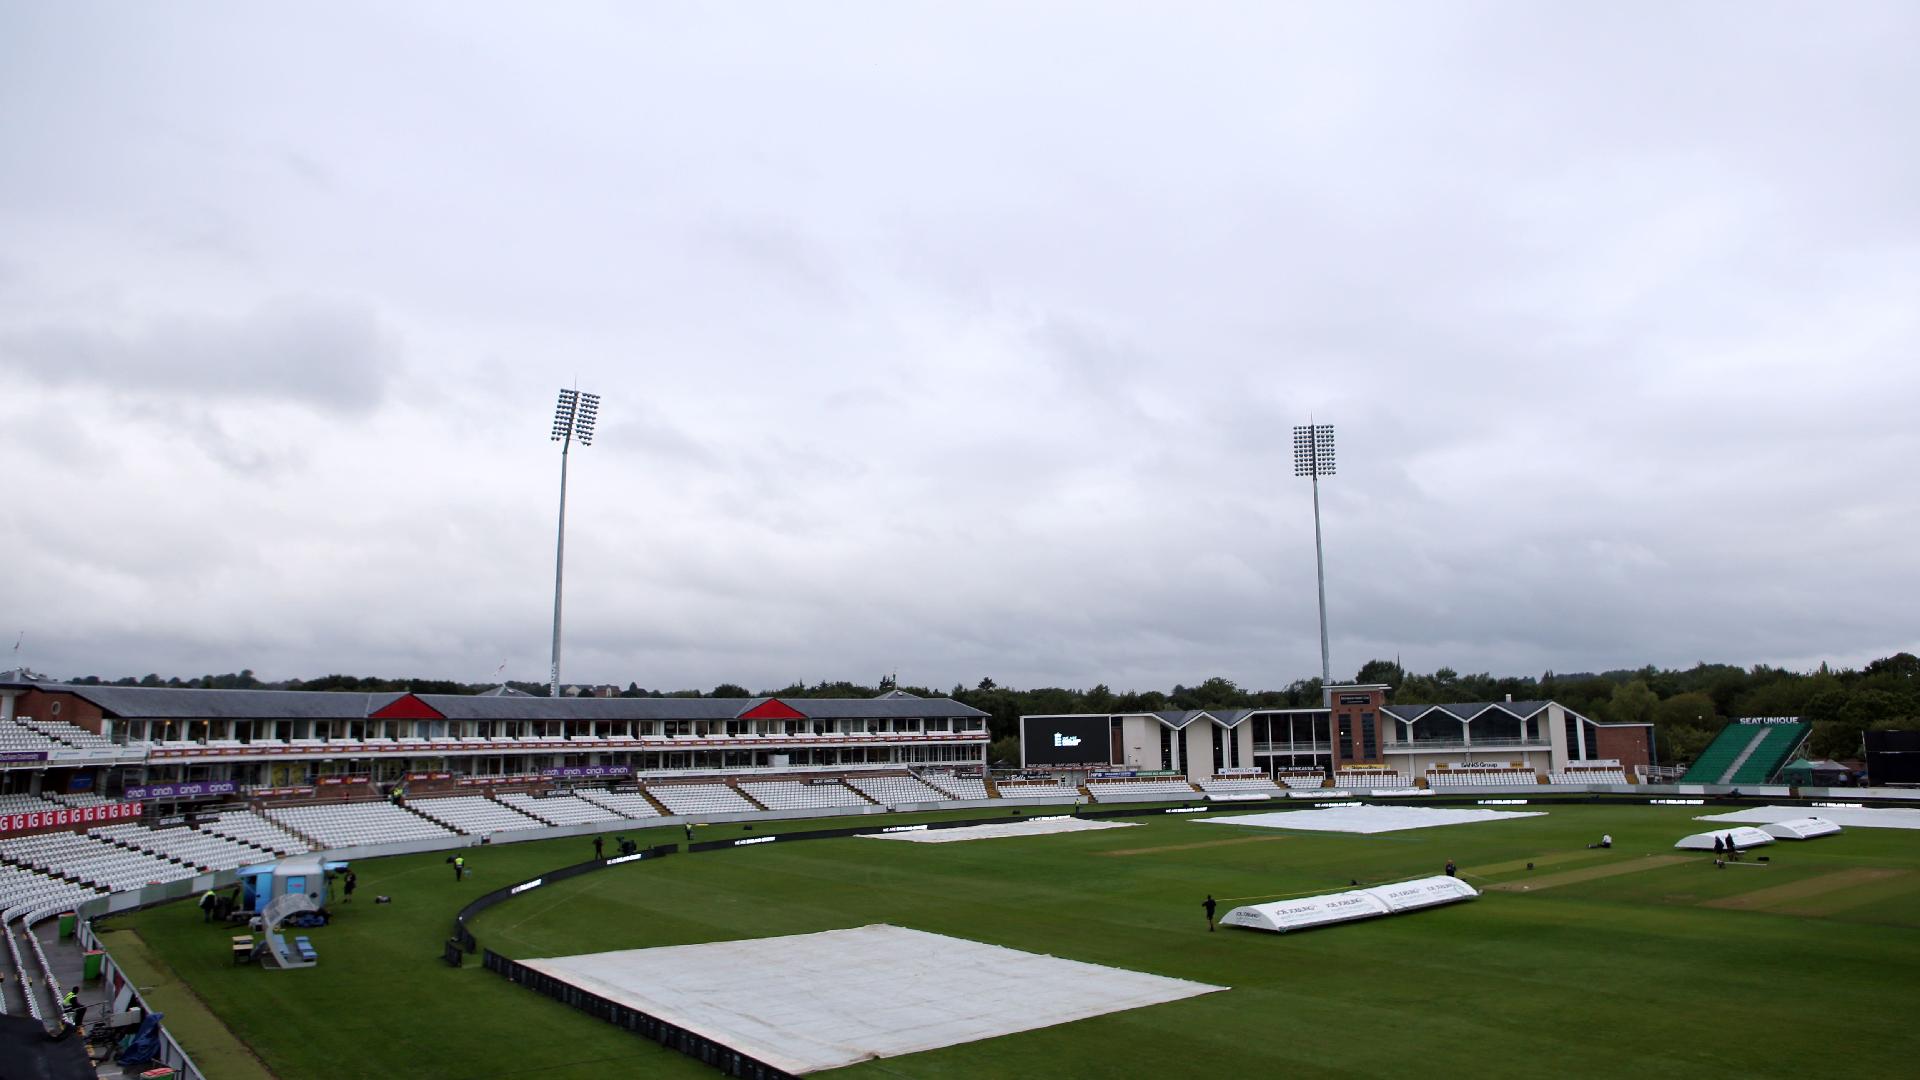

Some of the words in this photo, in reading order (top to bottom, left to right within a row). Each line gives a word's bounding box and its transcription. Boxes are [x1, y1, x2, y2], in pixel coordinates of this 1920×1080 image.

[1763, 716, 1799, 724] UNIQUE
[152, 786, 173, 796] cinch
[180, 784, 202, 794] cinch
[209, 783, 233, 793] cinch
[12, 815, 23, 829] IG
[28, 813, 39, 827] IG
[43, 812, 53, 826] IG
[57, 811, 67, 824] IG
[71, 809, 81, 822] IG
[84, 808, 93, 821] IG
[97, 806, 106, 819] IG
[109, 805, 118, 818] IG
[121, 804, 130, 817] IG
[133, 803, 142, 816] IG
